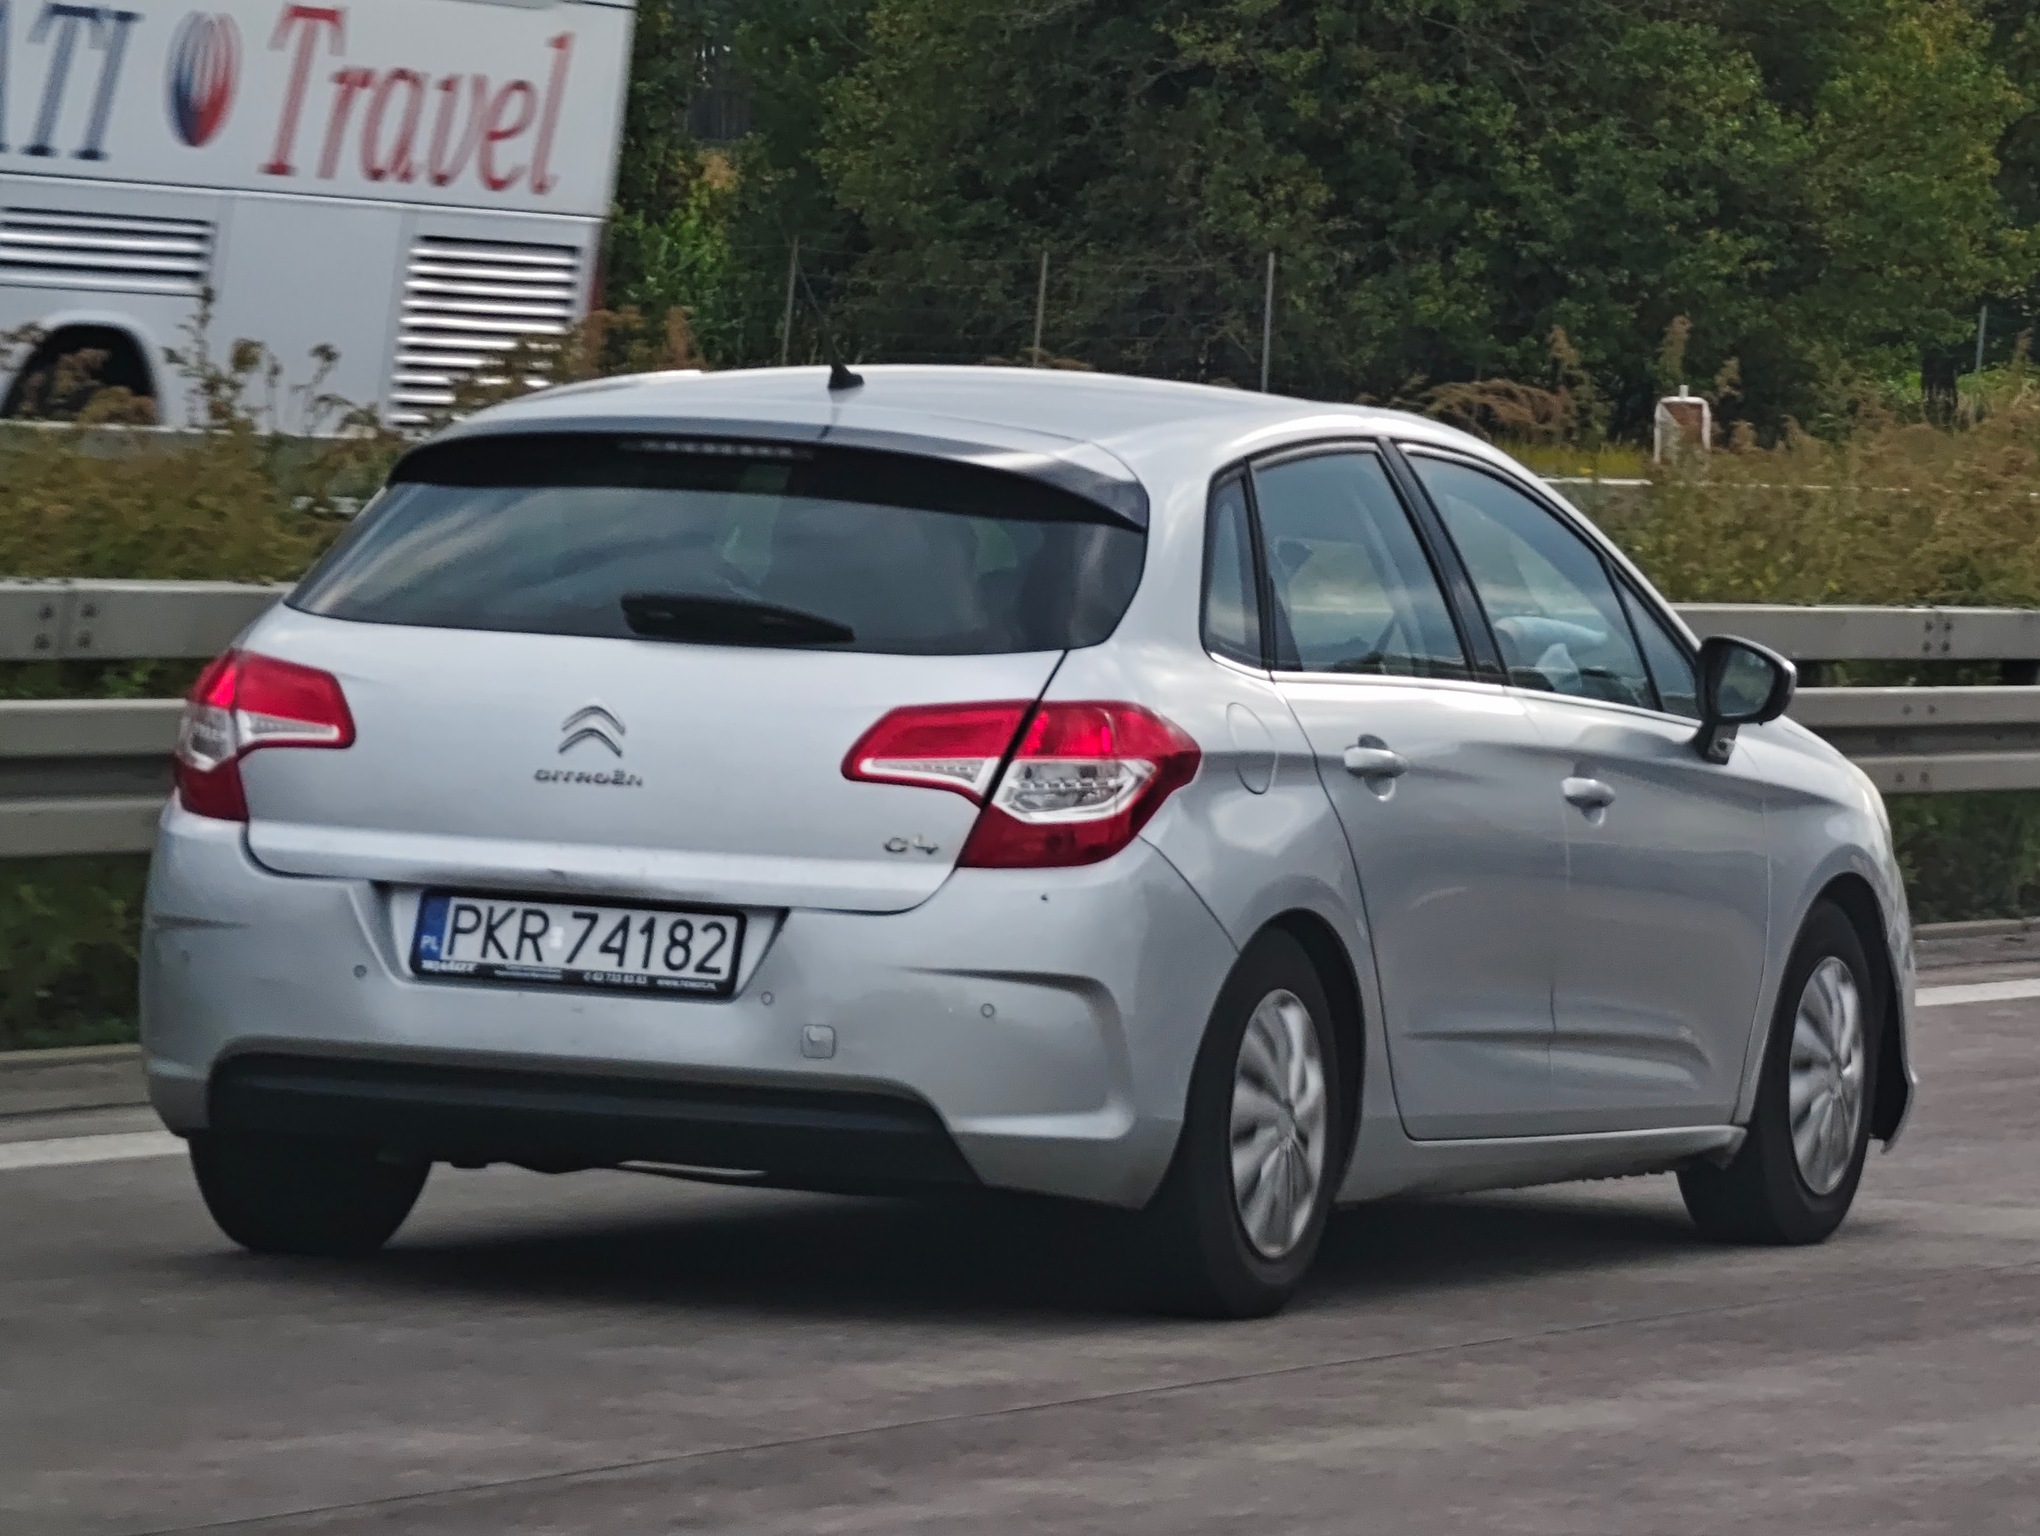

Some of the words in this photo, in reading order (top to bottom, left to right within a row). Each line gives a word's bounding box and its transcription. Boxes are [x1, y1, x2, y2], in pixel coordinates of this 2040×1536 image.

[0, 3, 143, 162] TI
[258, 3, 576, 196] Travel
[534, 769, 643, 787] CITROËN
[883, 834, 939, 855] C4
[421, 935, 439, 951] PL
[447, 903, 550, 963] PKR
[564, 911, 728, 975] 74182
